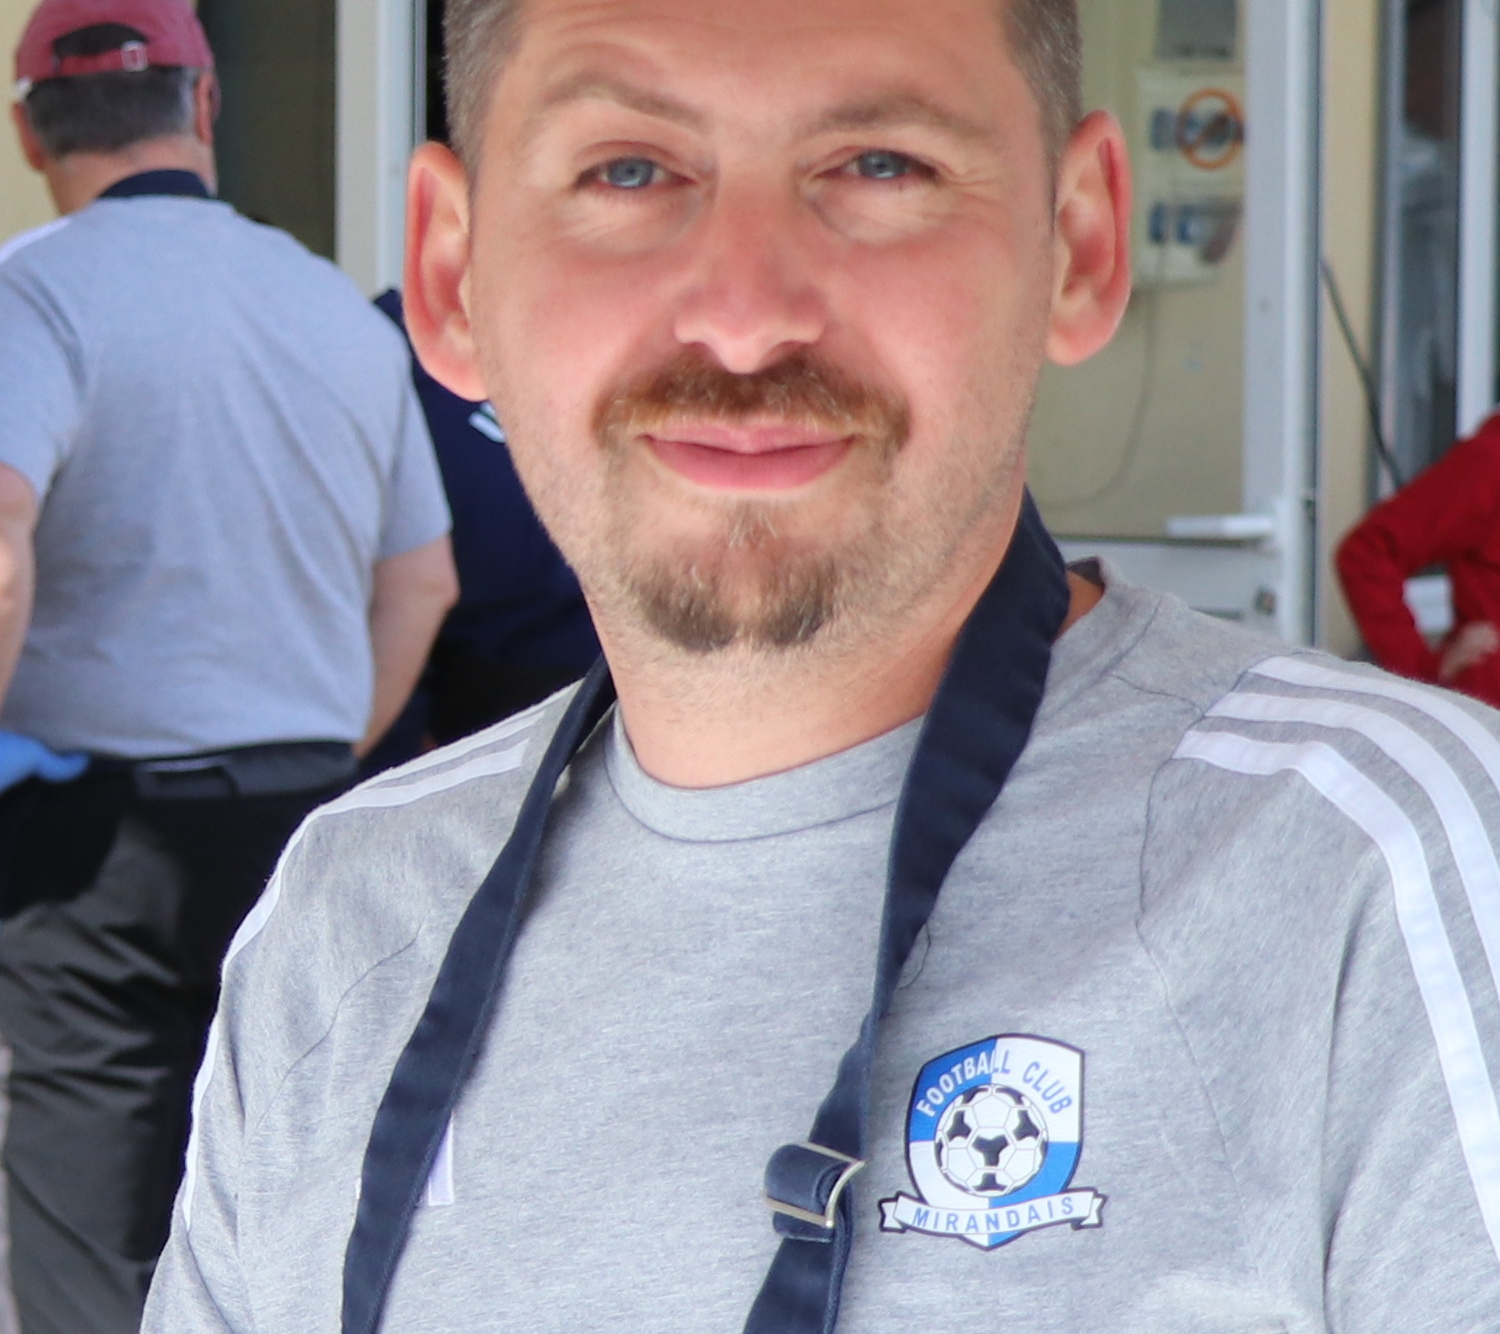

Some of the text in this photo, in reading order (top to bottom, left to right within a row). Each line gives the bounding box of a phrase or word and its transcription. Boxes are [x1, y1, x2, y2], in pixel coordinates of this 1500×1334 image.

[915, 1049, 1073, 1117] FOOTBALL CLUB
[911, 1195, 1075, 1233] MIRANDAIS
